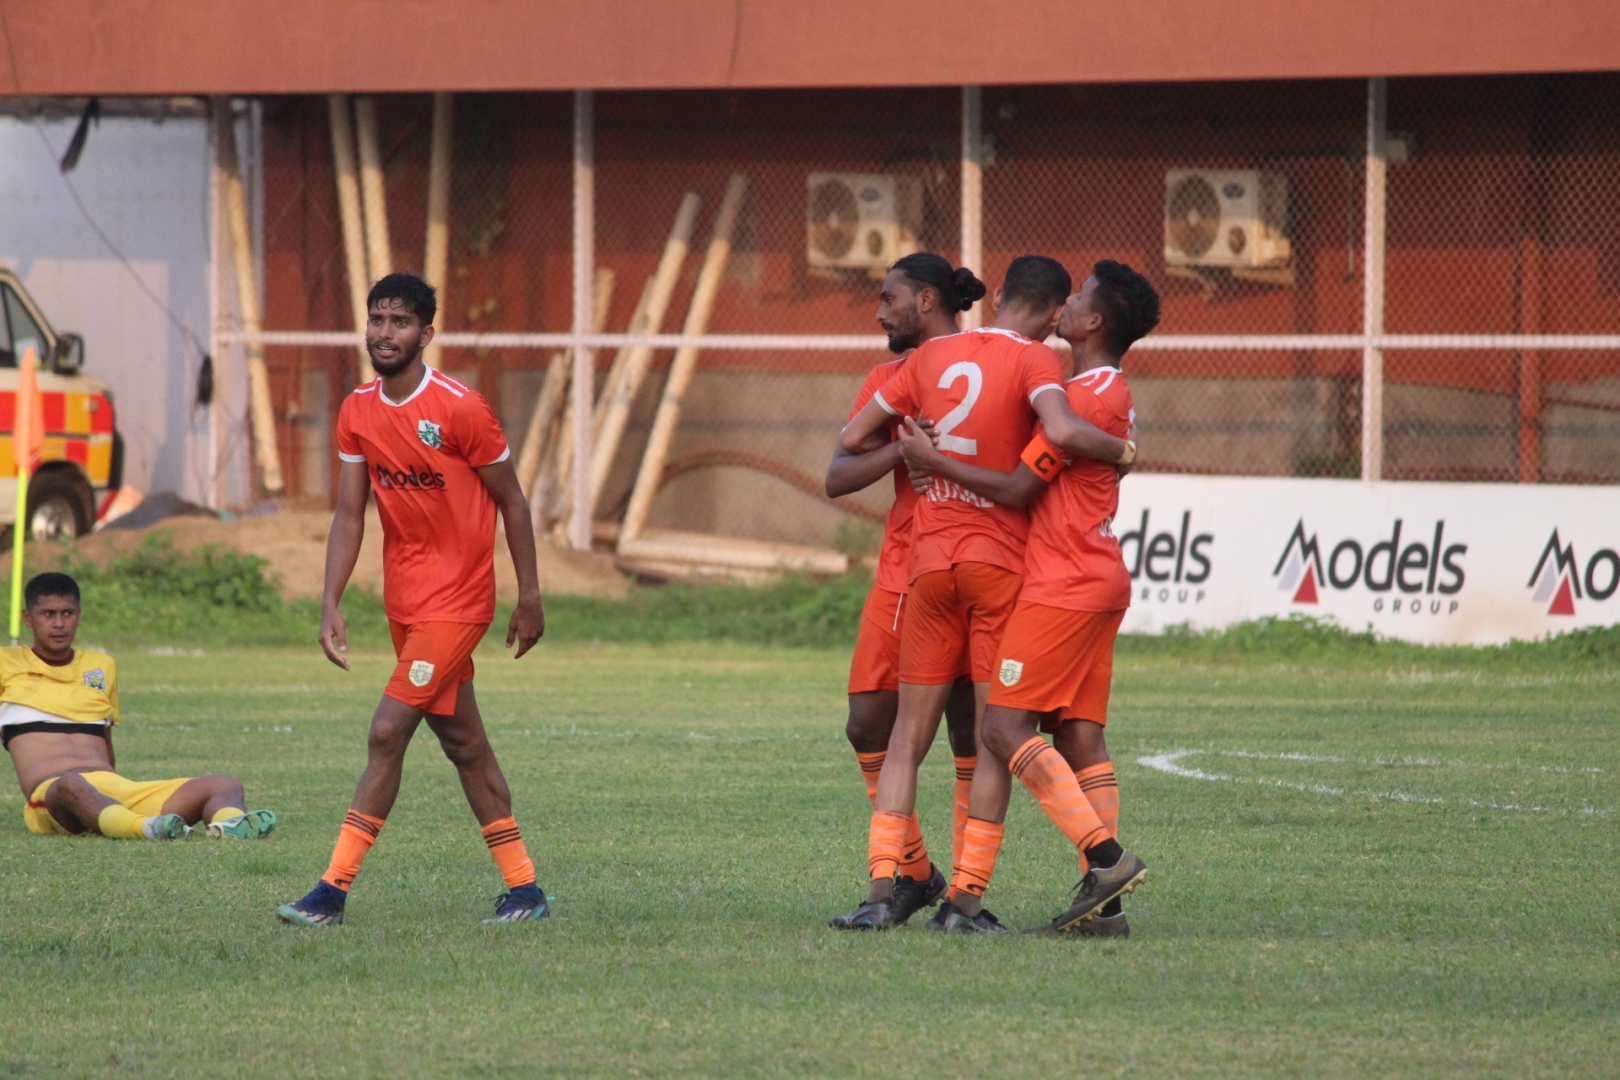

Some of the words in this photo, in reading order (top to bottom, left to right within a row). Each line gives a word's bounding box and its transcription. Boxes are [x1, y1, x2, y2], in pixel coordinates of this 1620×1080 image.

[936, 360, 983, 456] 2
[375, 462, 447, 489] Models
[1034, 451, 1057, 475] C
[1118, 508, 1215, 584] dels
[1272, 515, 1468, 595] Models
[1140, 587, 1207, 605] ROUP
[1373, 597, 1460, 615] GROUP
